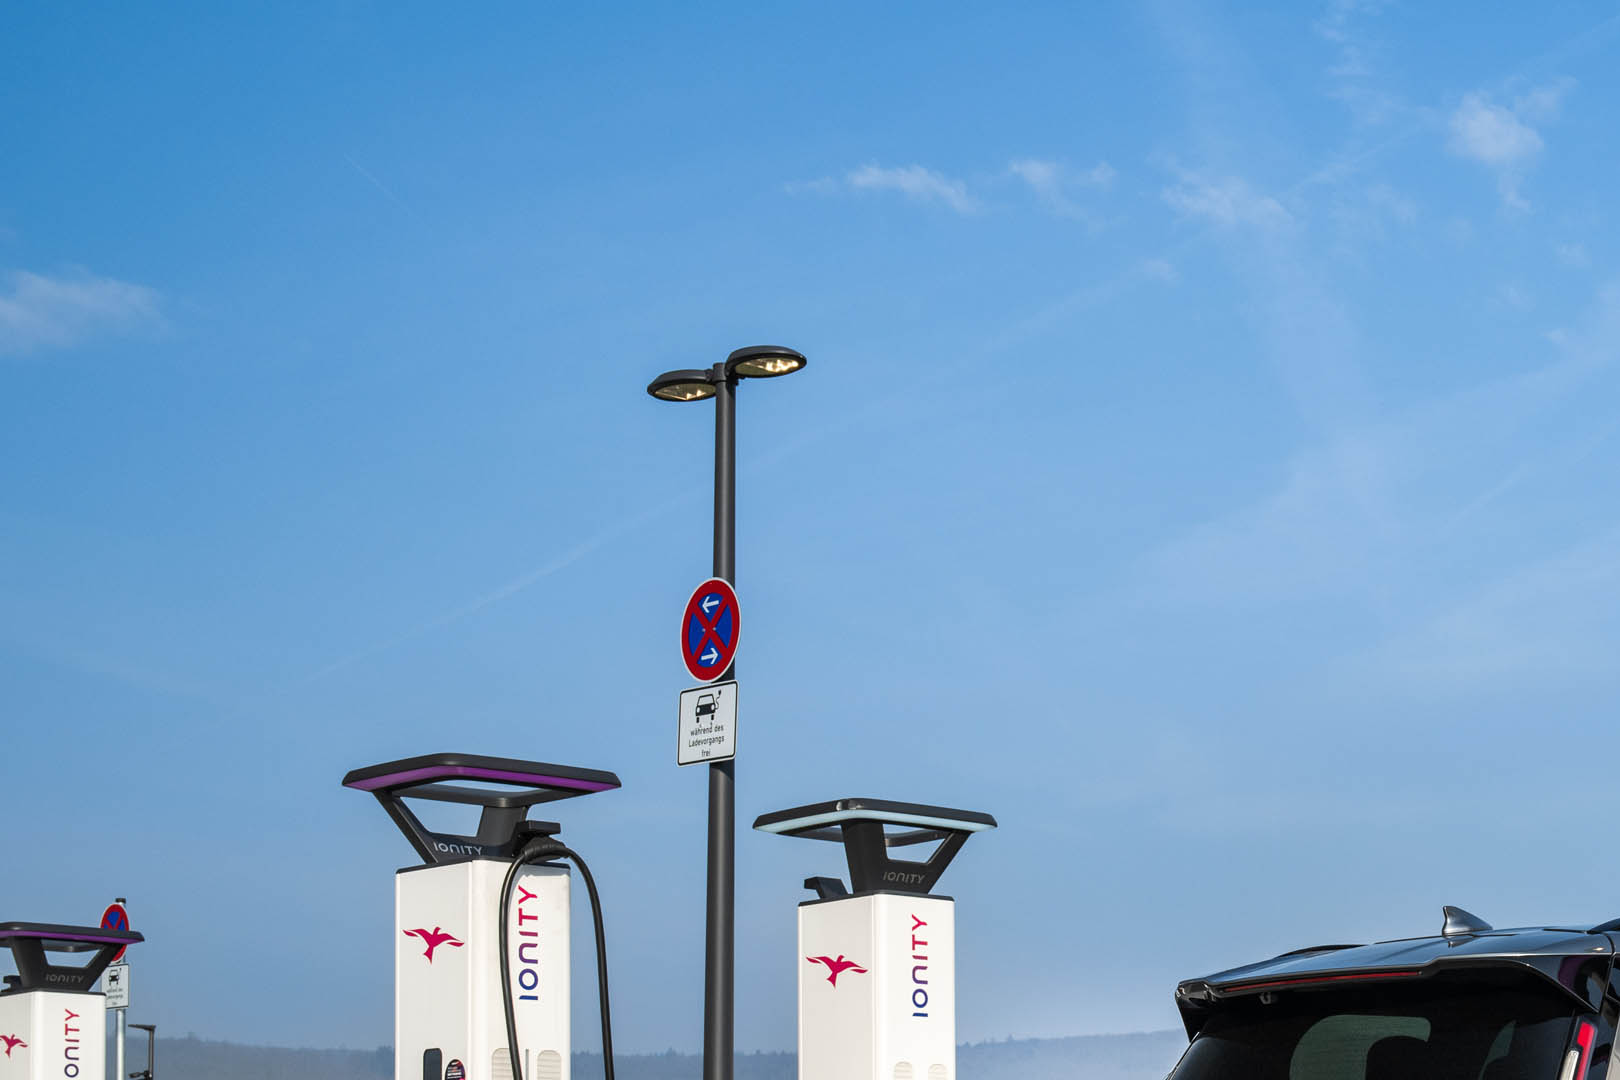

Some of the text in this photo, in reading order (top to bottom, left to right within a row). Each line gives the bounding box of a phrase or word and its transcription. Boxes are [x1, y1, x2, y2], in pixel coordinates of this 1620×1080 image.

[688, 736, 725, 748] Ladevorgangs
[701, 749, 711, 757] frei
[433, 841, 483, 856] IONITY
[883, 871, 926, 884] IONITY
[518, 885, 539, 1001] IONITY
[911, 914, 929, 1018] IONITY
[46, 973, 84, 983] IONITY
